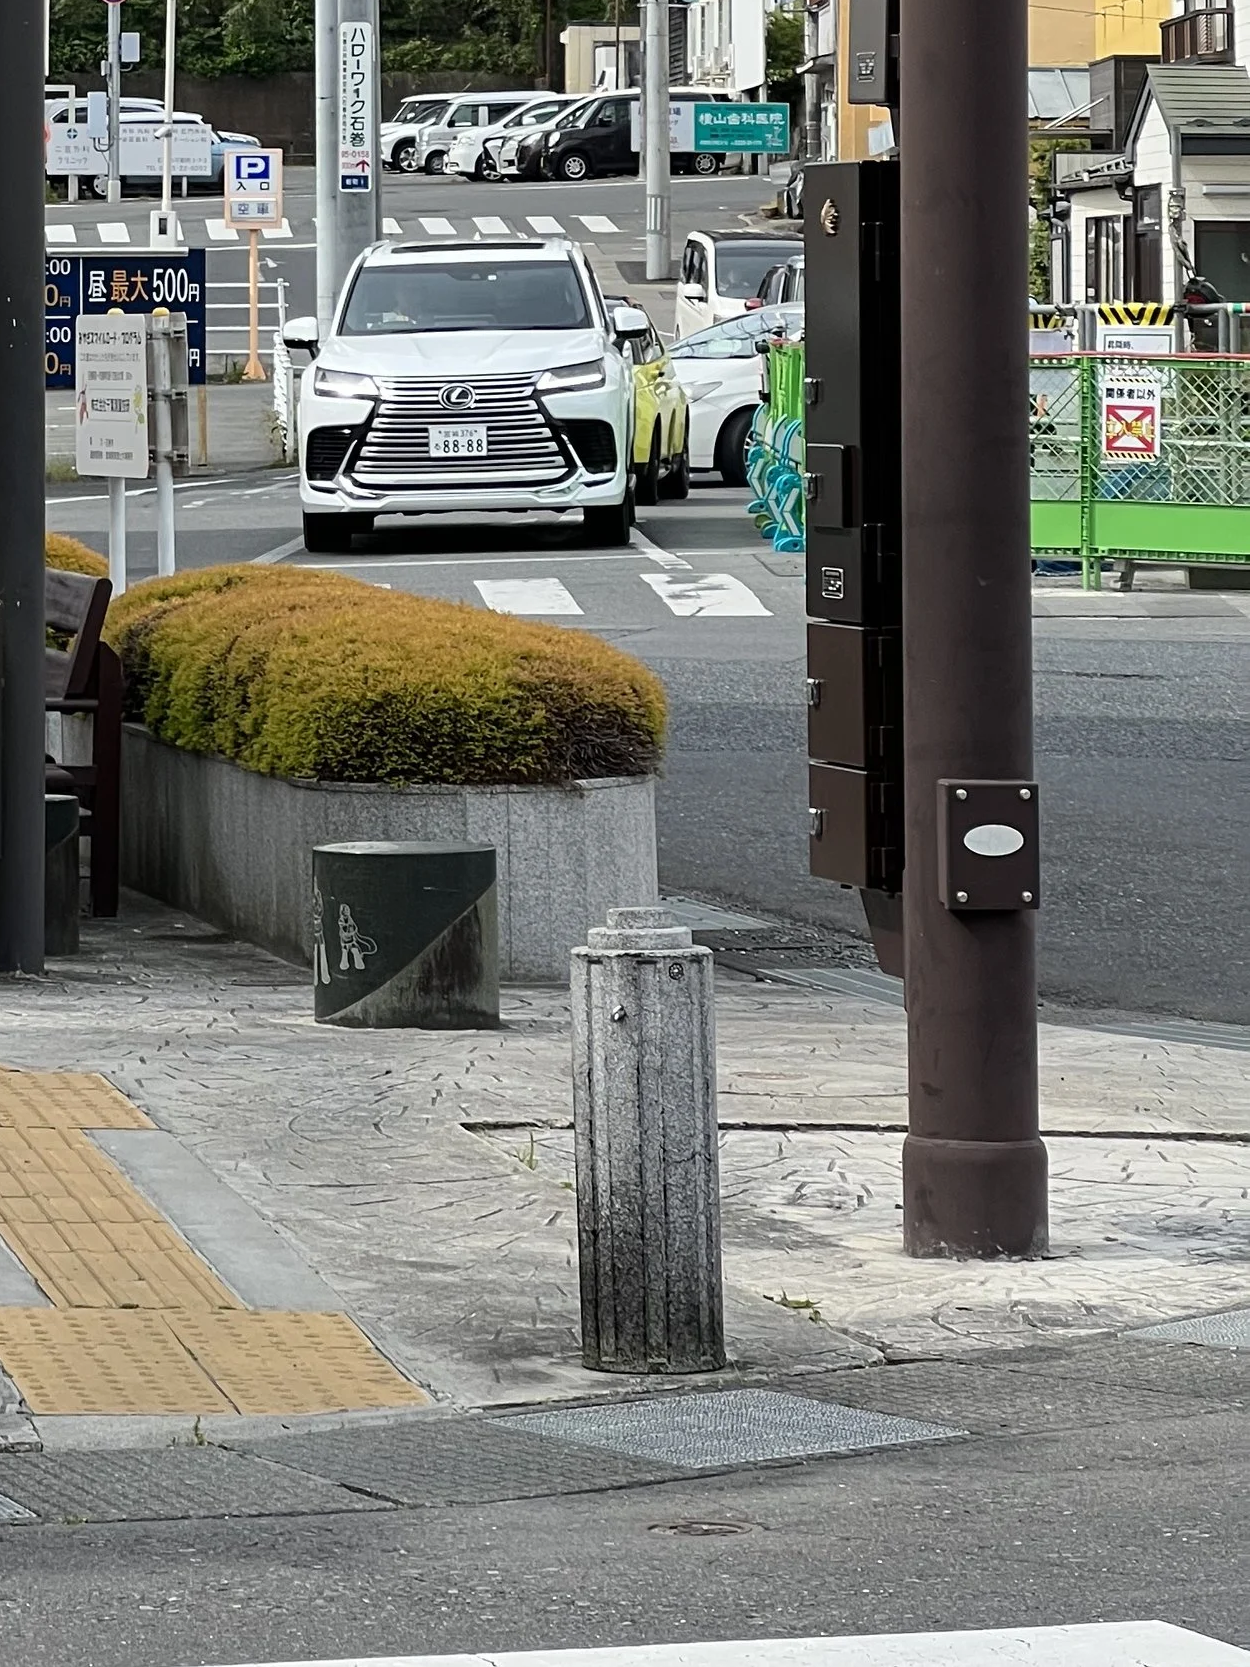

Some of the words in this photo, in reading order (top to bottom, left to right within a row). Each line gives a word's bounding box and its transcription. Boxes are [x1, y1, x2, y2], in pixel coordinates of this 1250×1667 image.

[350, 27, 366, 148] ハローワーク石巻
[240, 157, 265, 178] P
[236, 181, 270, 191] 入口
[443, 438, 484, 454] 88-88
